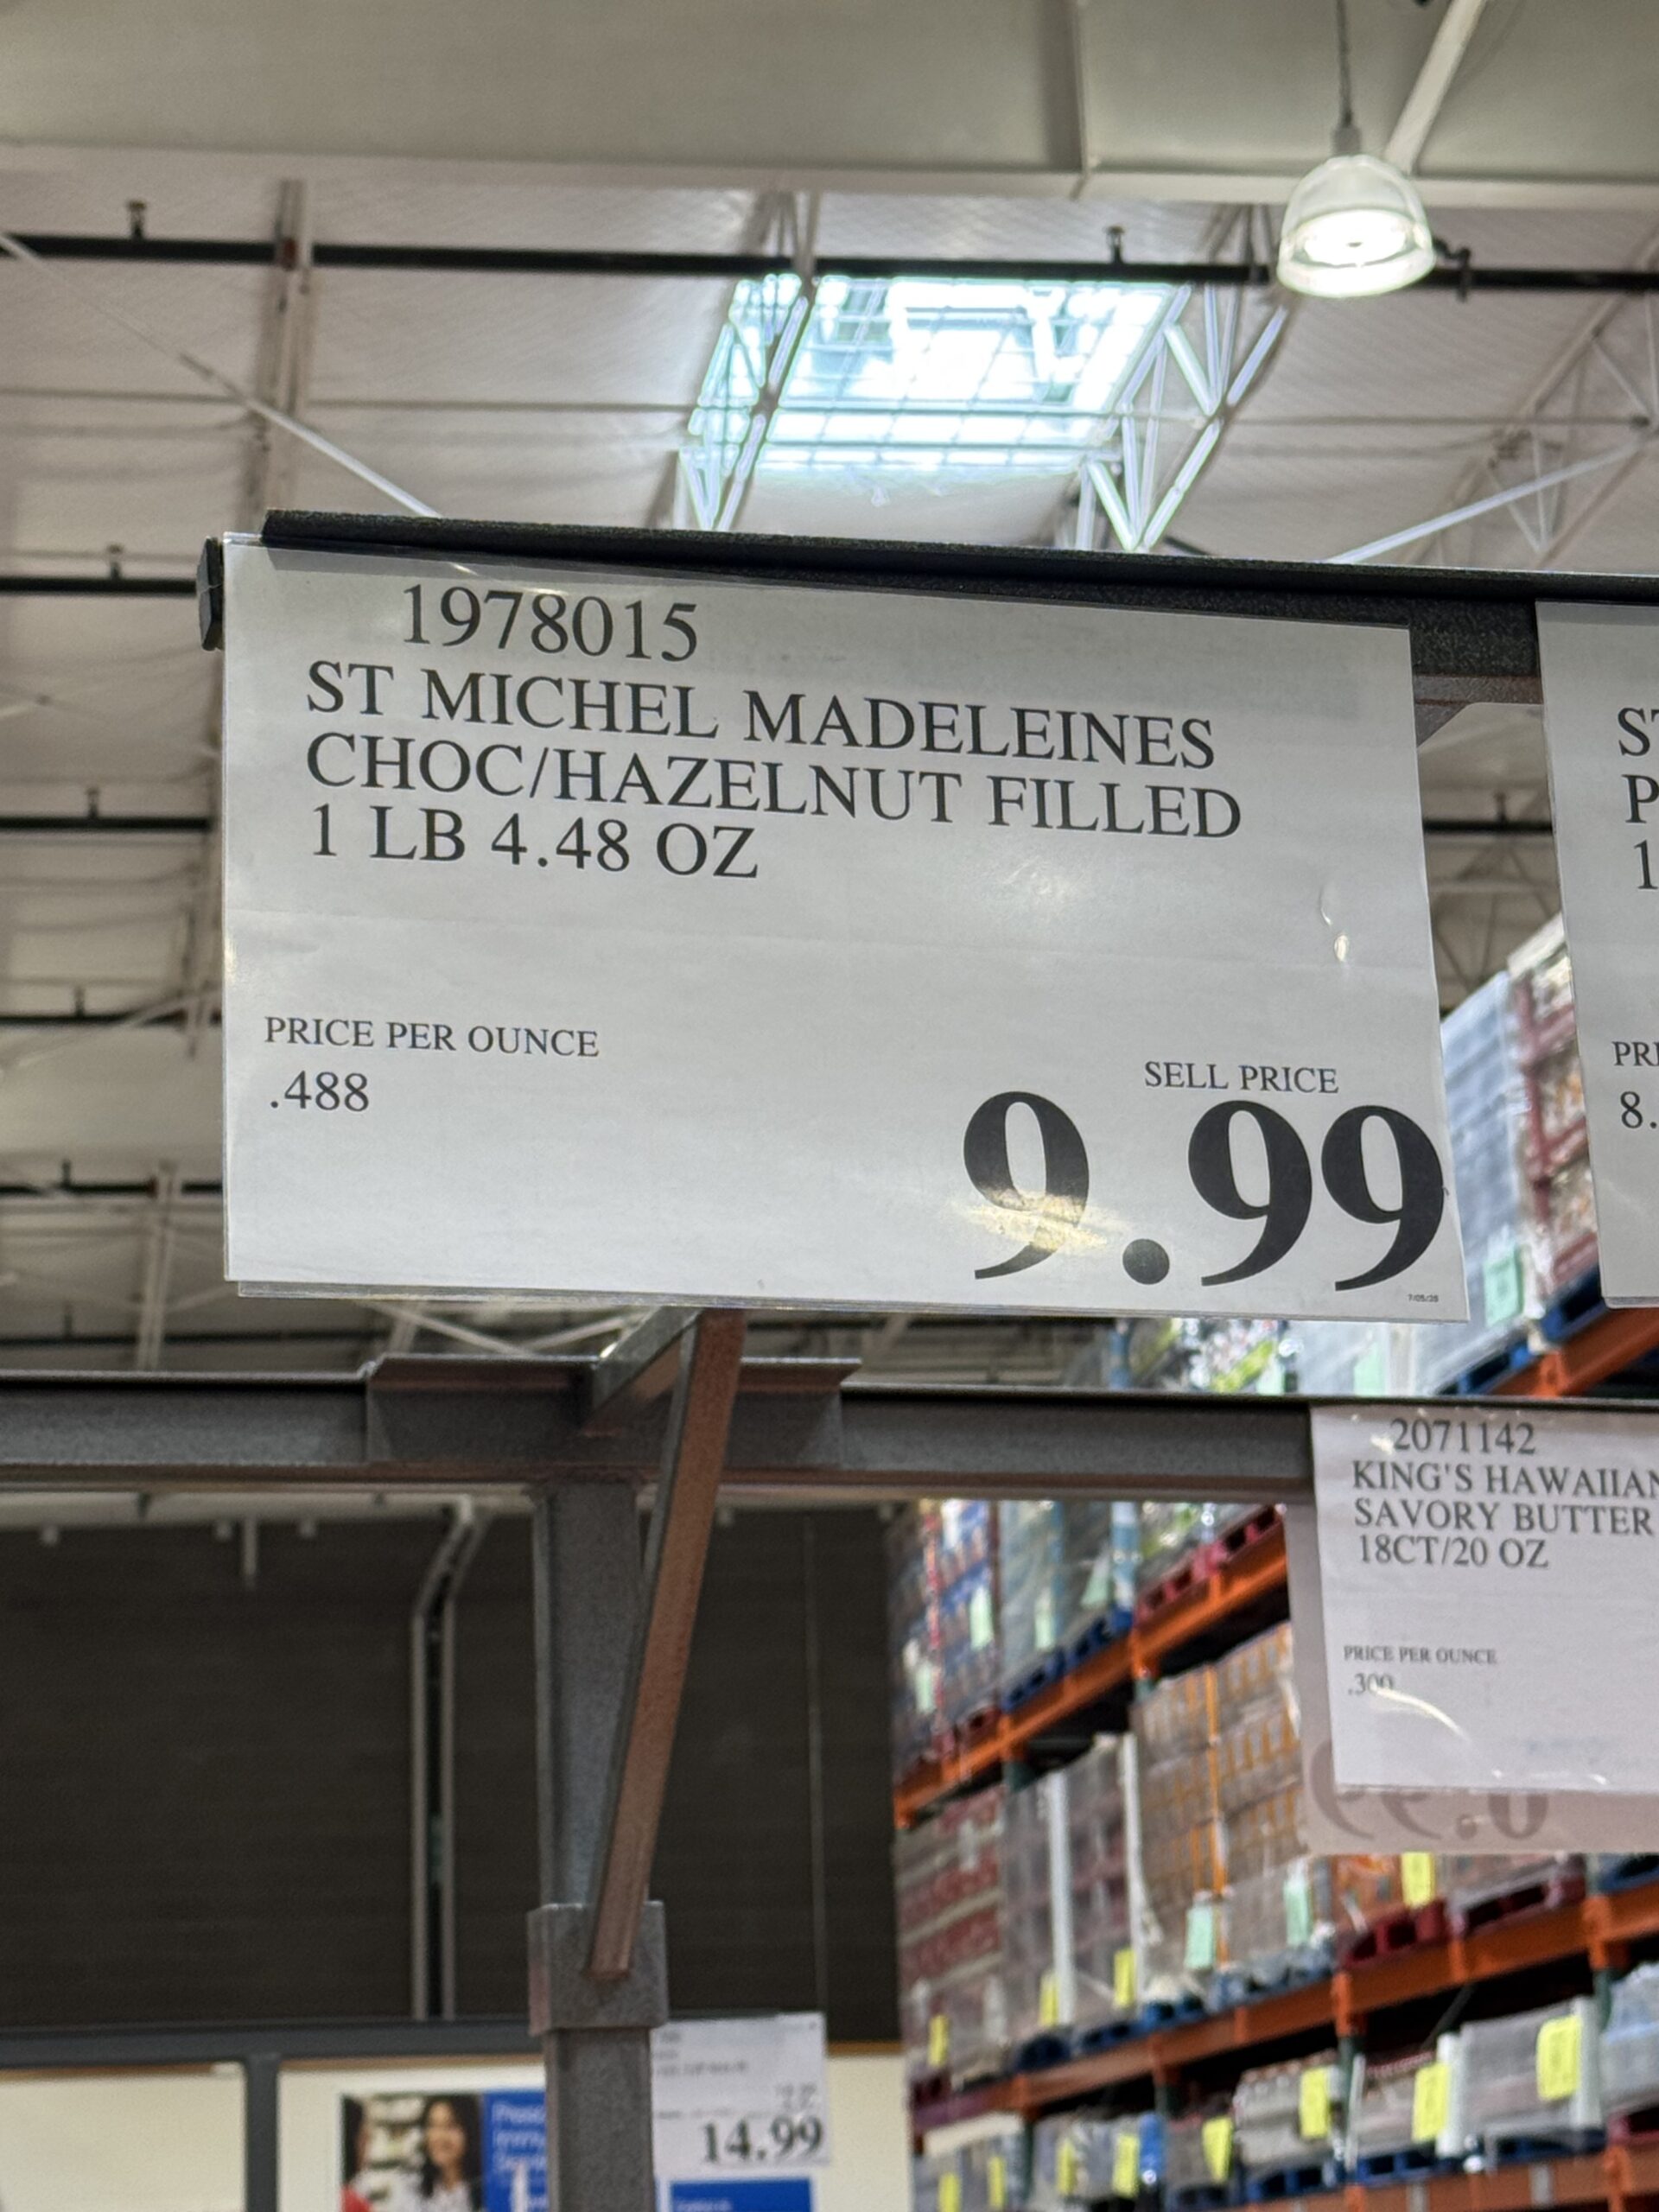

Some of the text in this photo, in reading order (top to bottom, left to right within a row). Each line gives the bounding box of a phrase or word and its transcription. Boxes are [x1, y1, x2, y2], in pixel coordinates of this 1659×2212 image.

[402, 582, 699, 663] 1978015
[304, 659, 1216, 771] ST MICHEL MADELEINES
[1617, 707, 1659, 757] S
[305, 731, 1243, 839] CHOC/HAZELNUT FILLED
[311, 804, 760, 879] 1 LB 4.48 OZ
[264, 1015, 601, 1058] PRICE PER OUNCE
[270, 1070, 371, 1113] .488
[1144, 1060, 1340, 1096] SELL PRICE
[963, 1090, 1446, 1293] 9.99
[1390, 1416, 1536, 1456] 2071142
[1352, 1459, 1474, 1493] KING'S
[1353, 1496, 1654, 1538] SAVORY BUTTER
[1359, 1531, 1550, 1569] 18CT/20 OZ
[1344, 1644, 1498, 1666] PRICE PER OUNCE
[701, 2114, 823, 2164] 14.99
